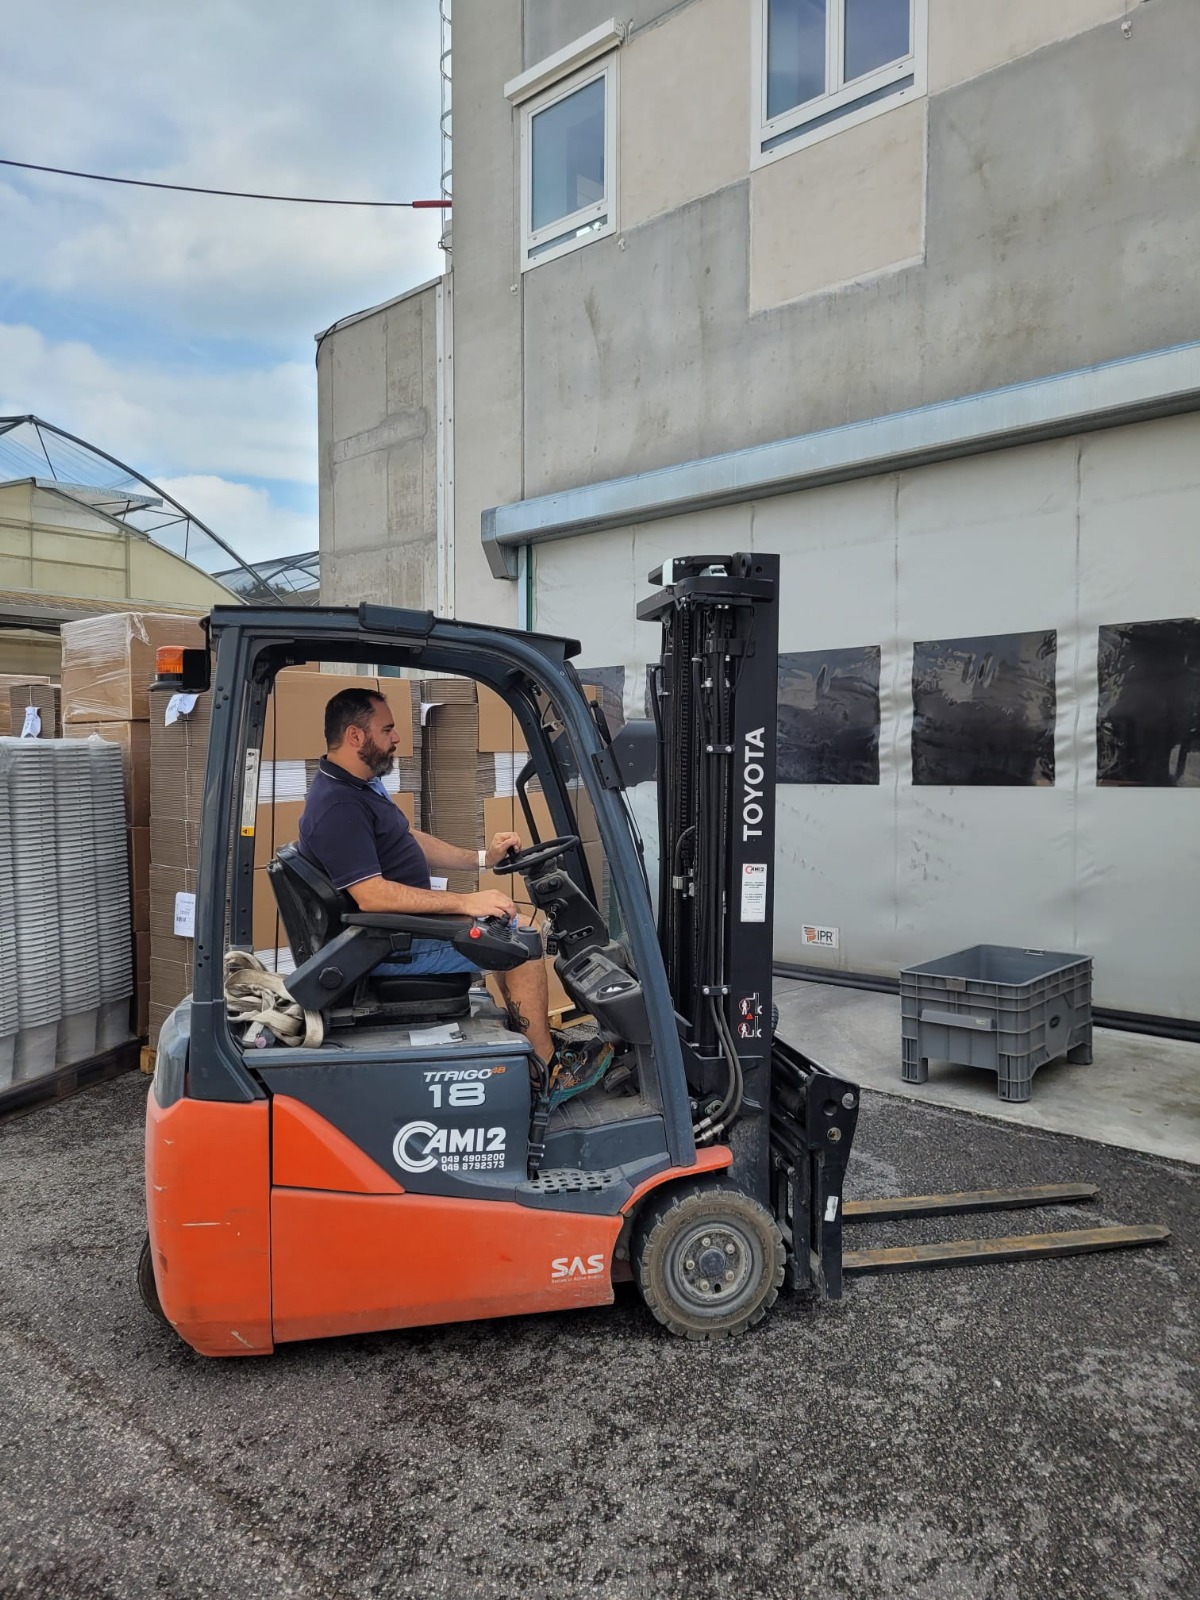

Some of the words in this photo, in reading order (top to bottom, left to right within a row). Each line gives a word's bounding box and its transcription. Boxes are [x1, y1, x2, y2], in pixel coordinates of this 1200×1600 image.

[743, 727, 765, 841] TOYOTA
[817, 930, 833, 942] IPR
[428, 1082, 486, 1108] 18
[441, 1155, 460, 1164] 049
[462, 1153, 505, 1163] 4905200
[441, 1163, 460, 1172] 049
[462, 1161, 505, 1171] 8792373
[551, 1254, 604, 1278] SAS
